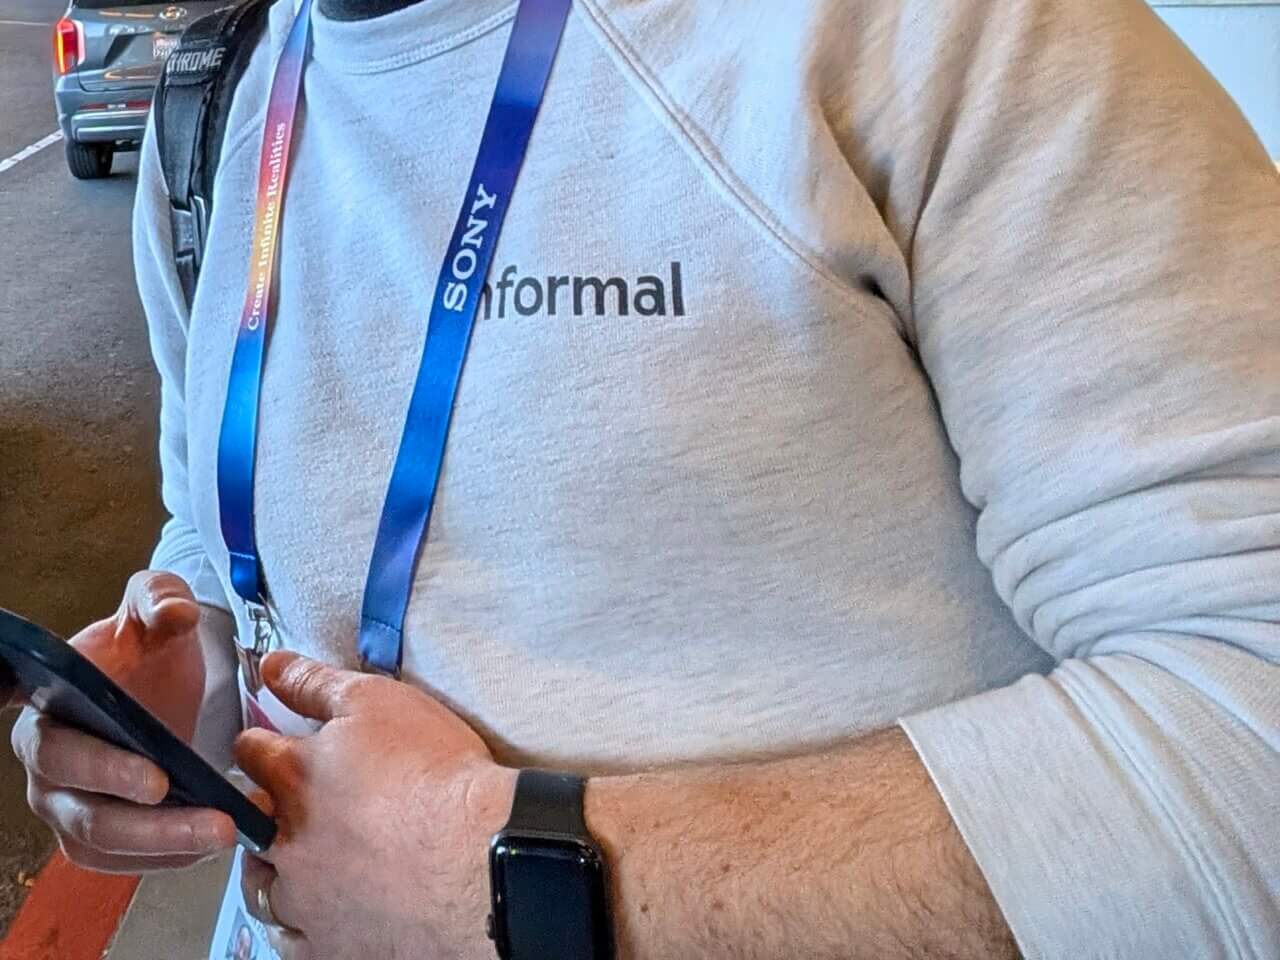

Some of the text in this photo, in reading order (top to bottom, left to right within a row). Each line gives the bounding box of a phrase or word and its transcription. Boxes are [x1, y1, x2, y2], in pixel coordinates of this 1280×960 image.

[248, 122, 286, 331] Create Infinite Realities
[443, 183, 497, 312] SONY
